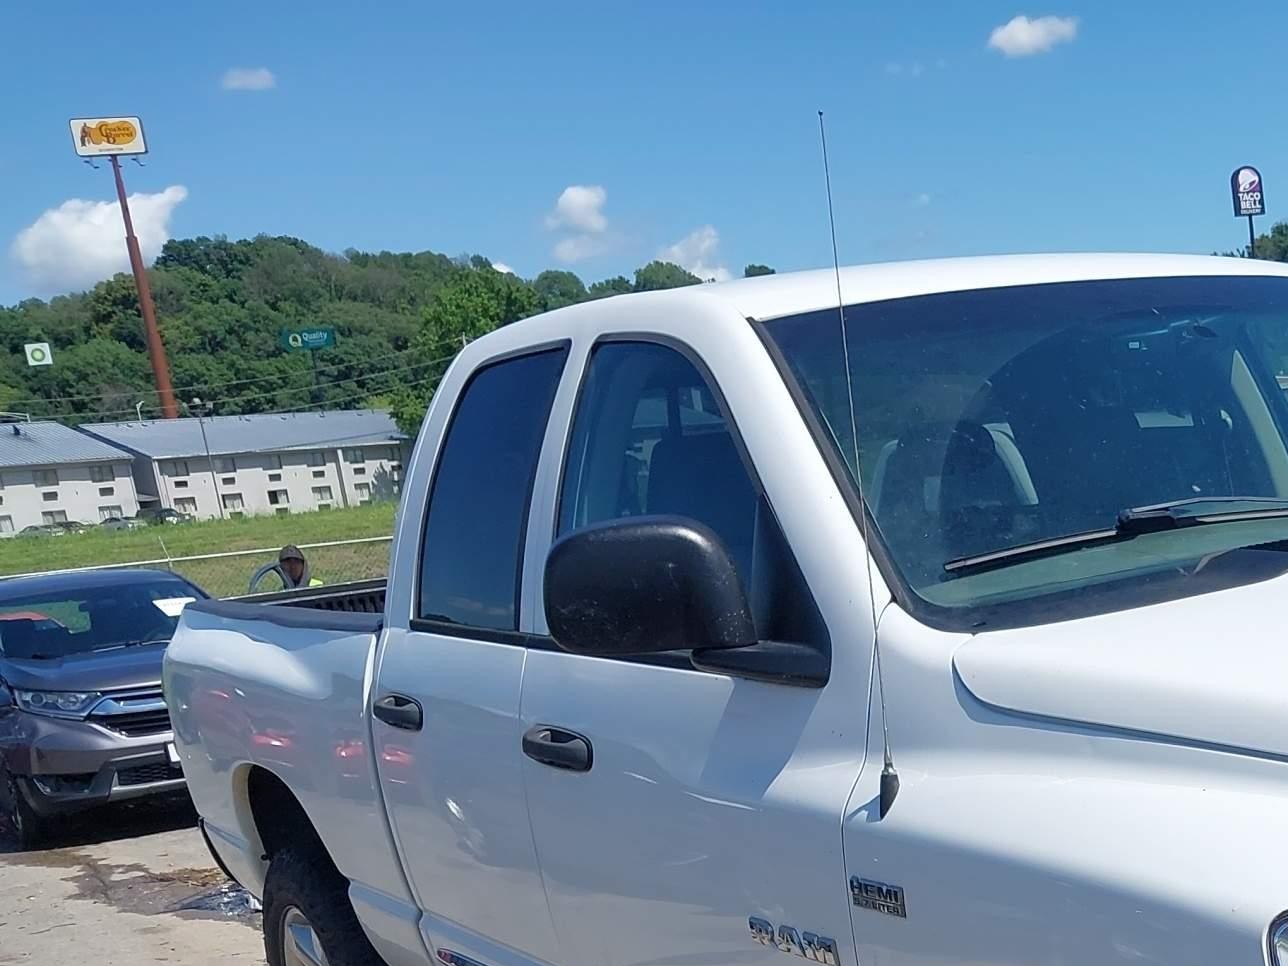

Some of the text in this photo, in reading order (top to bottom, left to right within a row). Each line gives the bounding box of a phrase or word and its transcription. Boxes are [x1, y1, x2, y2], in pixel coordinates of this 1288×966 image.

[1238, 191, 1260, 201] TACO
[1241, 200, 1262, 209] BELL
[850, 876, 904, 904] HEMI
